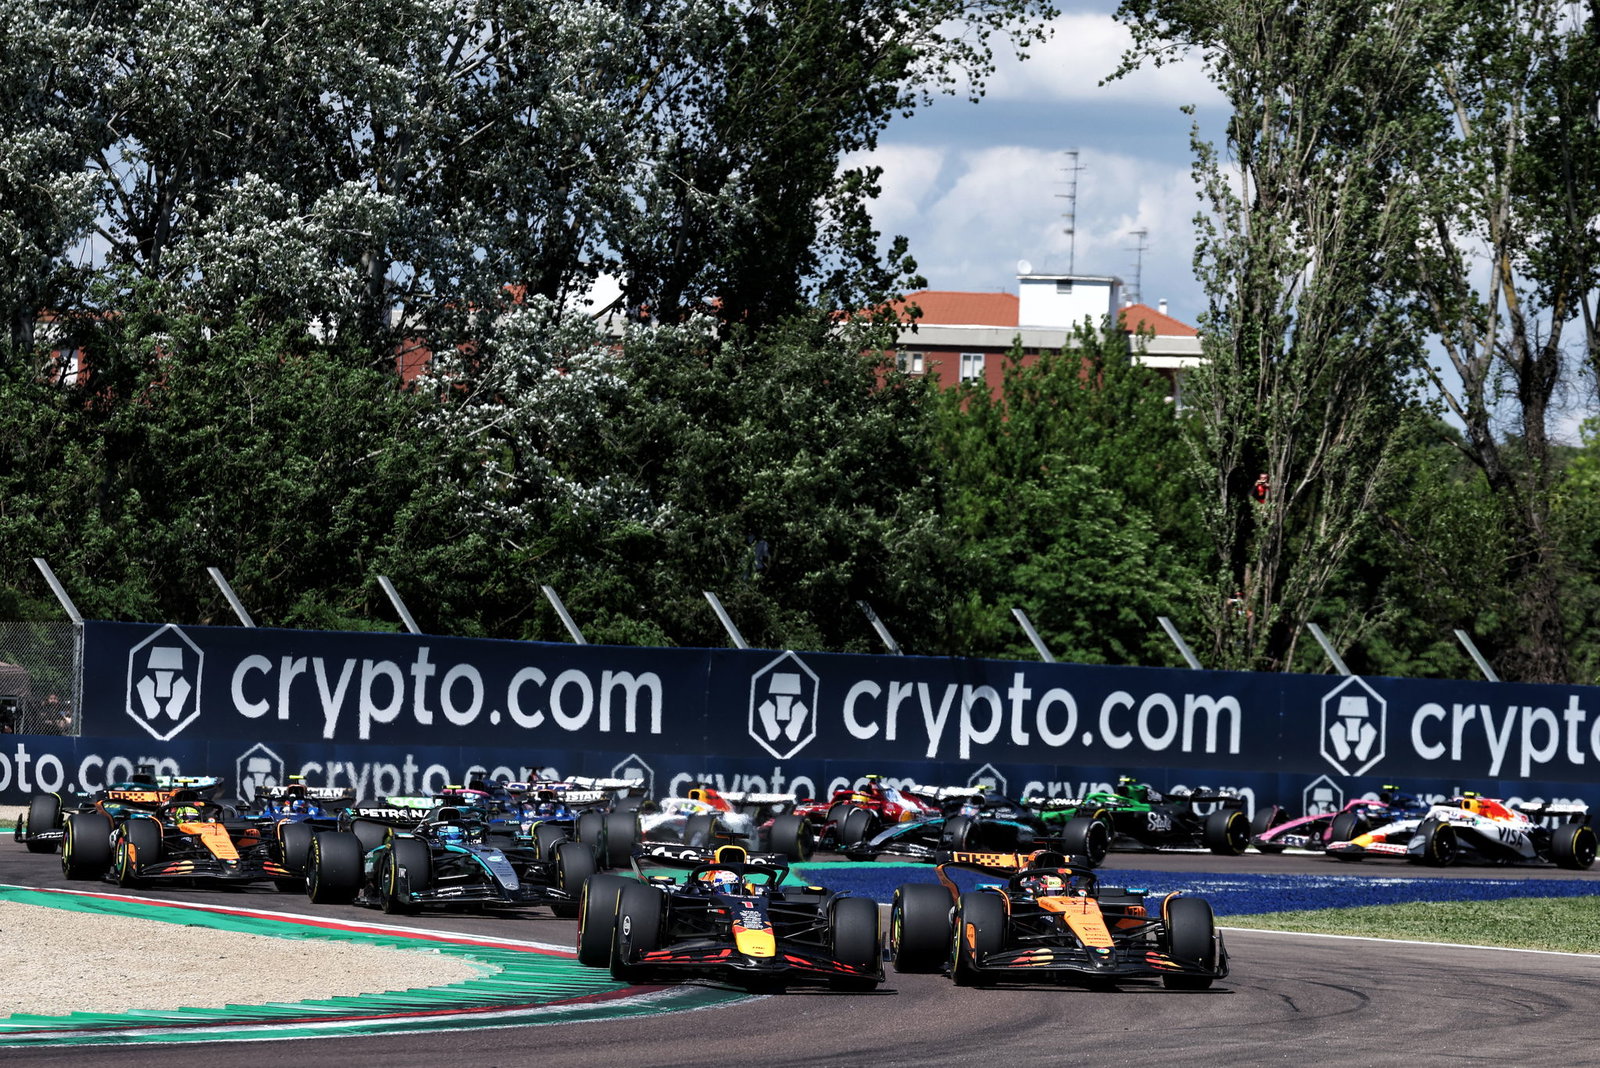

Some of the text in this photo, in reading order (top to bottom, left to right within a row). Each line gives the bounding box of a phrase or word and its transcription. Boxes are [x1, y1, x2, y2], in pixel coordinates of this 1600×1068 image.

[230, 646, 663, 740] crypto.com
[842, 672, 1242, 760] crypto.com
[1411, 694, 1600, 778] crypt
[1496, 826, 1523, 847] VISA
